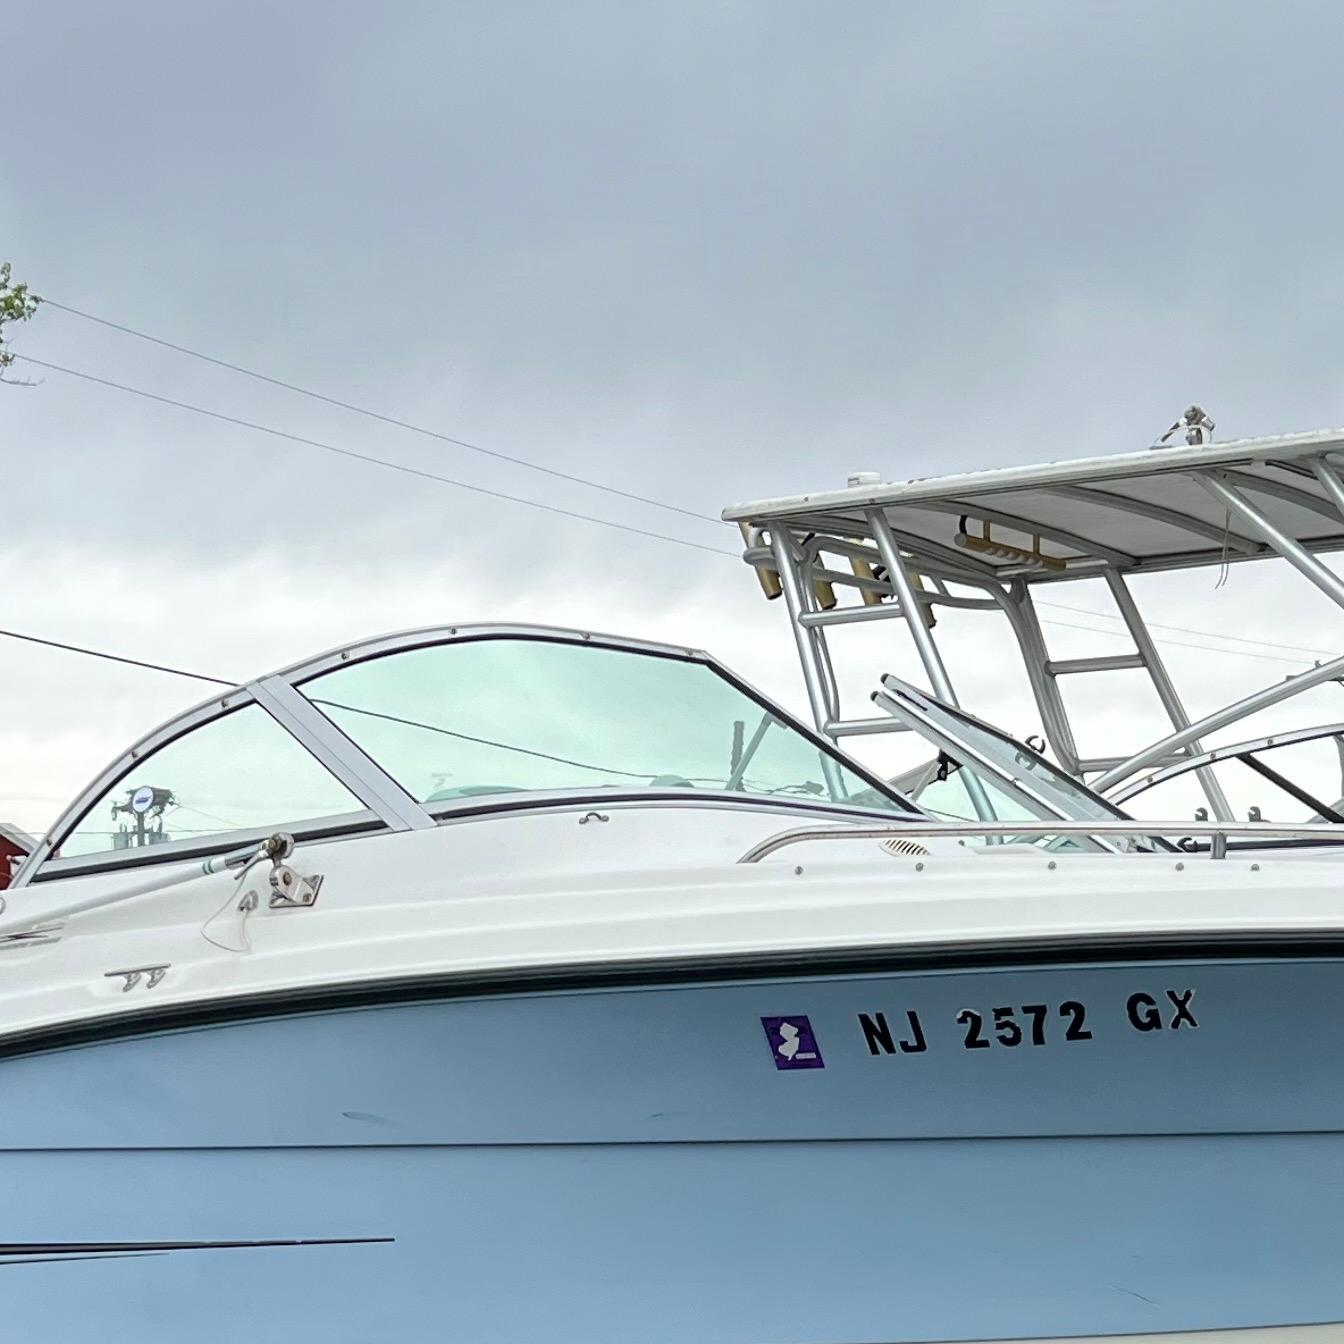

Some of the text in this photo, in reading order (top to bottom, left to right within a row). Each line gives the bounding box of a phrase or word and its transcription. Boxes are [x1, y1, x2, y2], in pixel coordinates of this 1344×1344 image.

[857, 989, 1199, 1056] NJ 2572 GX
